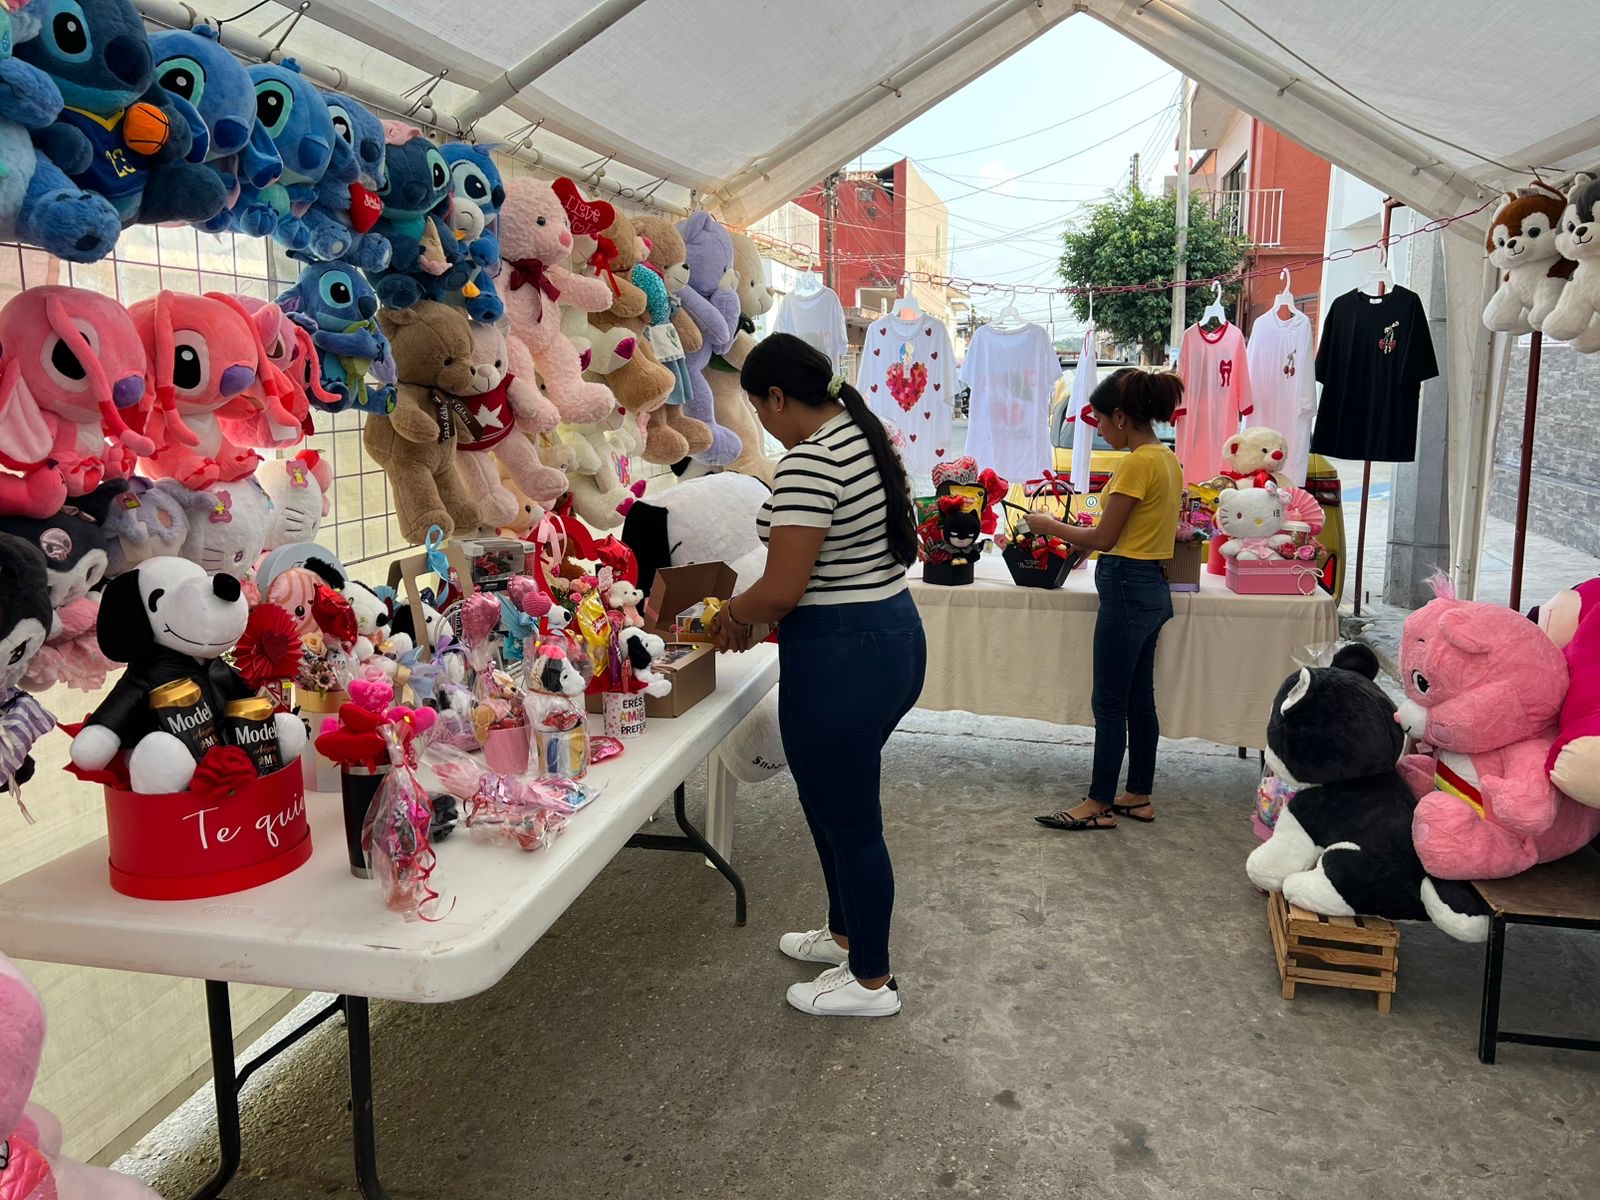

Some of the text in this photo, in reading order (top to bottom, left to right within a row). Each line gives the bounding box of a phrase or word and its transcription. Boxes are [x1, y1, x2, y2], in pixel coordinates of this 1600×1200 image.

[622, 697, 643, 709] ERES
[166, 702, 213, 735] Model
[235, 721, 280, 745] Model
[182, 806, 242, 849] Te
